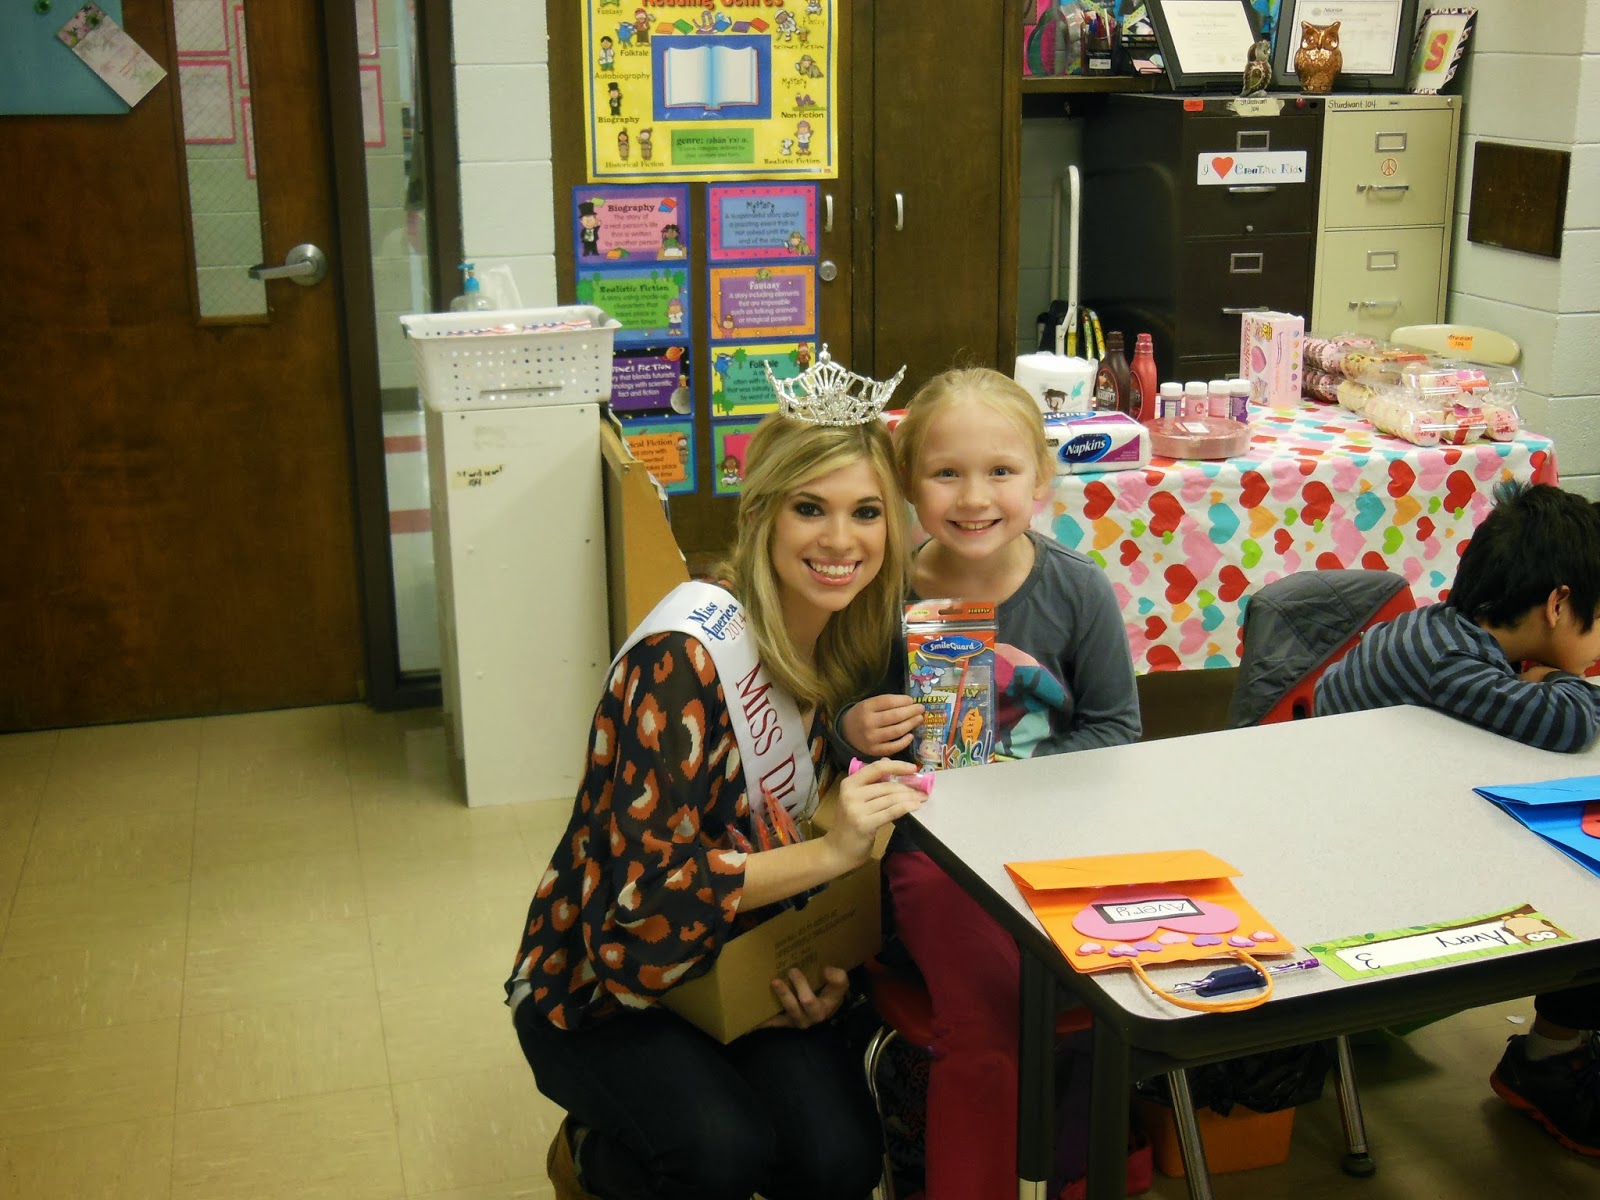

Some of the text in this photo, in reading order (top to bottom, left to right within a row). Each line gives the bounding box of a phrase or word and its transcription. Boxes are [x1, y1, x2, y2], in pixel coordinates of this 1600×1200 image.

[620, 49, 649, 57] Folktale
[1424, 33, 1448, 71] S
[594, 71, 651, 82] Autobiography
[1365, 100, 1376, 109] 104
[597, 116, 641, 125] Biography
[605, 160, 664, 170] Historical Fiction
[608, 204, 655, 214] Biography
[600, 284, 669, 294] Realistic Fiction
[749, 281, 781, 291] Fantasy
[735, 293, 748, 301] story
[749, 291, 774, 299] including
[775, 290, 800, 298] elements
[755, 308, 774, 316] talking
[746, 316, 770, 324] magical
[770, 315, 792, 323] powers
[620, 374, 632, 382] that
[632, 373, 652, 381] blends
[613, 383, 635, 391] nology
[635, 381, 648, 389] with
[643, 389, 660, 397] fiction
[646, 438, 673, 448] Fiction
[1066, 438, 1106, 457] Napkins
[686, 601, 719, 624] Miss
[701, 603, 738, 642] America
[725, 611, 748, 642] 2014
[930, 639, 976, 653] SmileGuard
[735, 661, 783, 757] MISS
[1115, 902, 1187, 917] Avery
[1435, 929, 1510, 948] Avery
